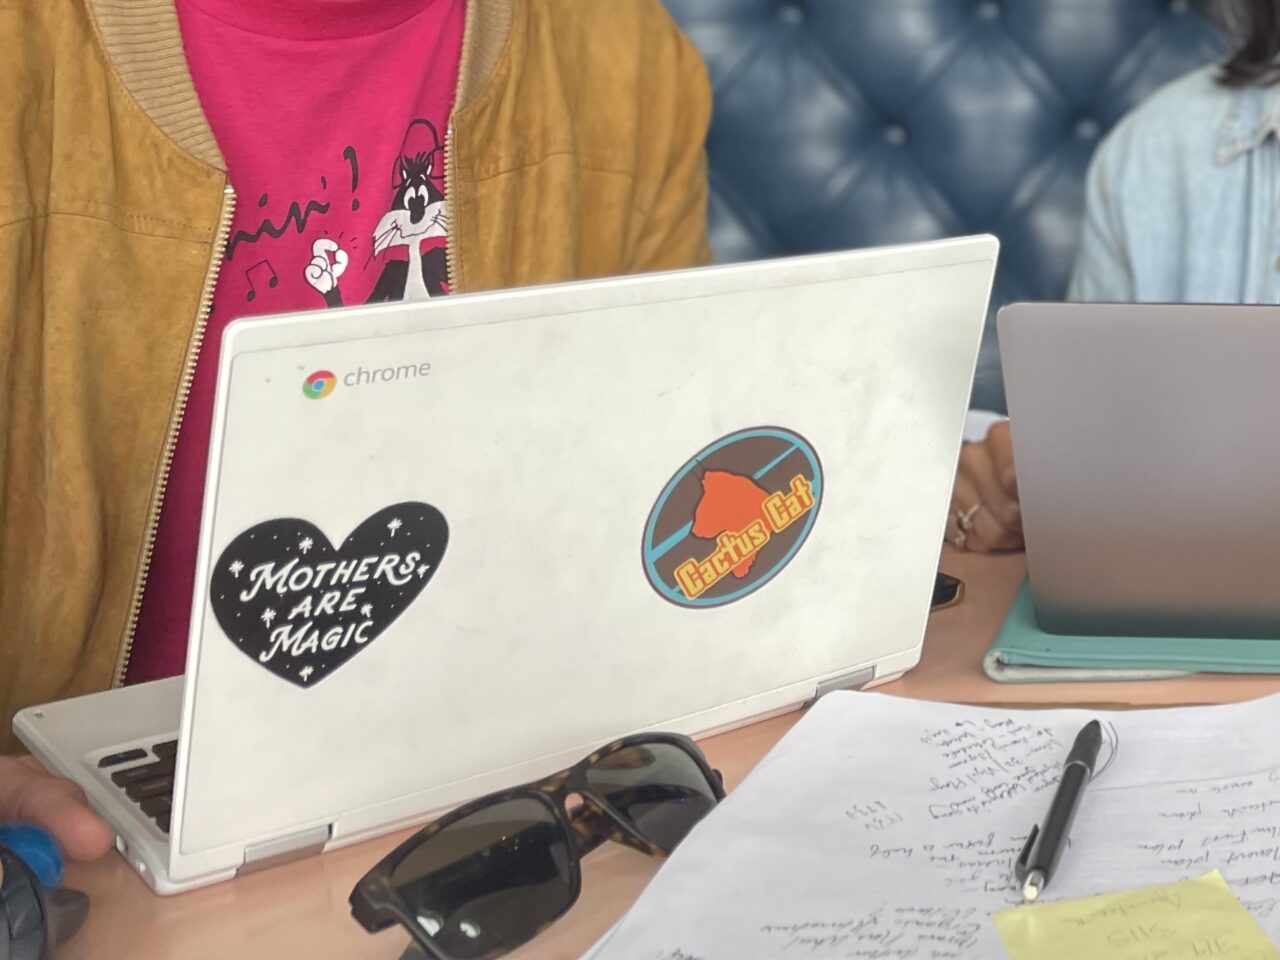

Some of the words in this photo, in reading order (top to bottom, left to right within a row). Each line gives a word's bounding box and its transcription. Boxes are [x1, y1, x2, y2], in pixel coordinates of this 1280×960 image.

[343, 362, 432, 387] chrome
[674, 518, 771, 601] Cactus
[762, 473, 816, 533] Cat
[239, 551, 421, 602] MOTHERS
[287, 587, 367, 621] ARE
[258, 621, 374, 663] MAGIC
